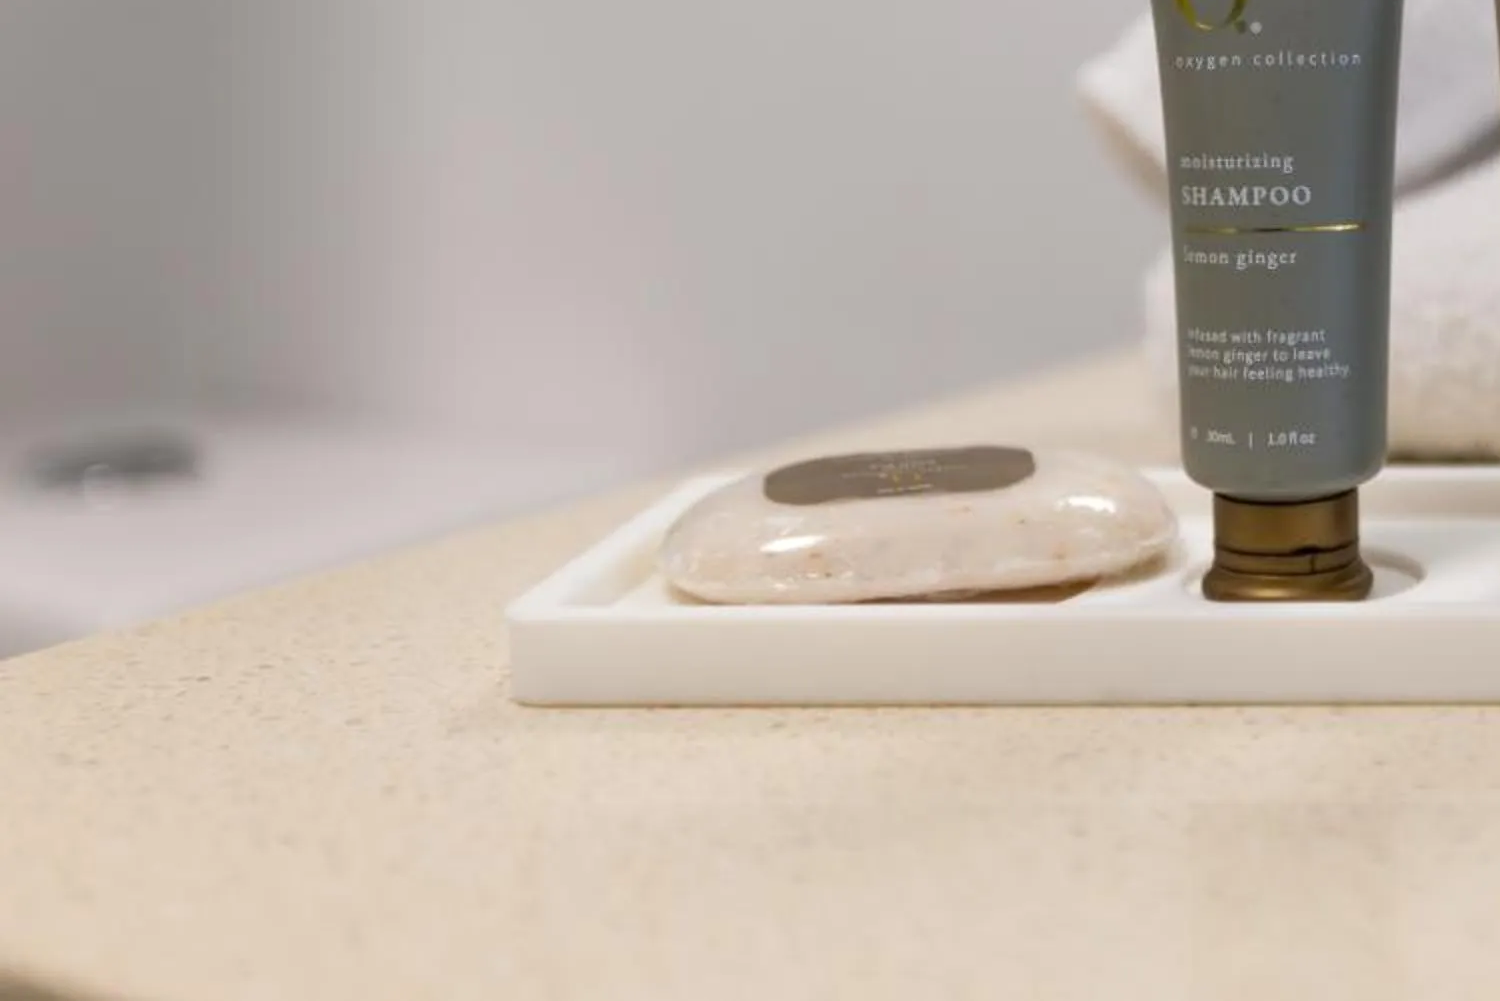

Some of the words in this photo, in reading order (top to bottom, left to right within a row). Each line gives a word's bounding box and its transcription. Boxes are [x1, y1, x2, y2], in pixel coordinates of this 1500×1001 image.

[1175, 55, 1241, 70] oxygen
[1253, 51, 1361, 66] collection
[1180, 154, 1294, 173] moisturizing
[1182, 185, 1312, 206] SHAMPOO
[1183, 246, 1229, 265] lemon
[1236, 248, 1297, 270] ginger
[1187, 327, 1227, 343] nfused
[1231, 329, 1261, 344] with
[1266, 329, 1325, 346] fragrant
[1223, 349, 1267, 364] ginger
[1273, 348, 1289, 362] to
[1293, 346, 1331, 361] leave
[1213, 363, 1237, 378] hair
[1243, 365, 1293, 382] feeling
[1298, 362, 1349, 380] healthy
